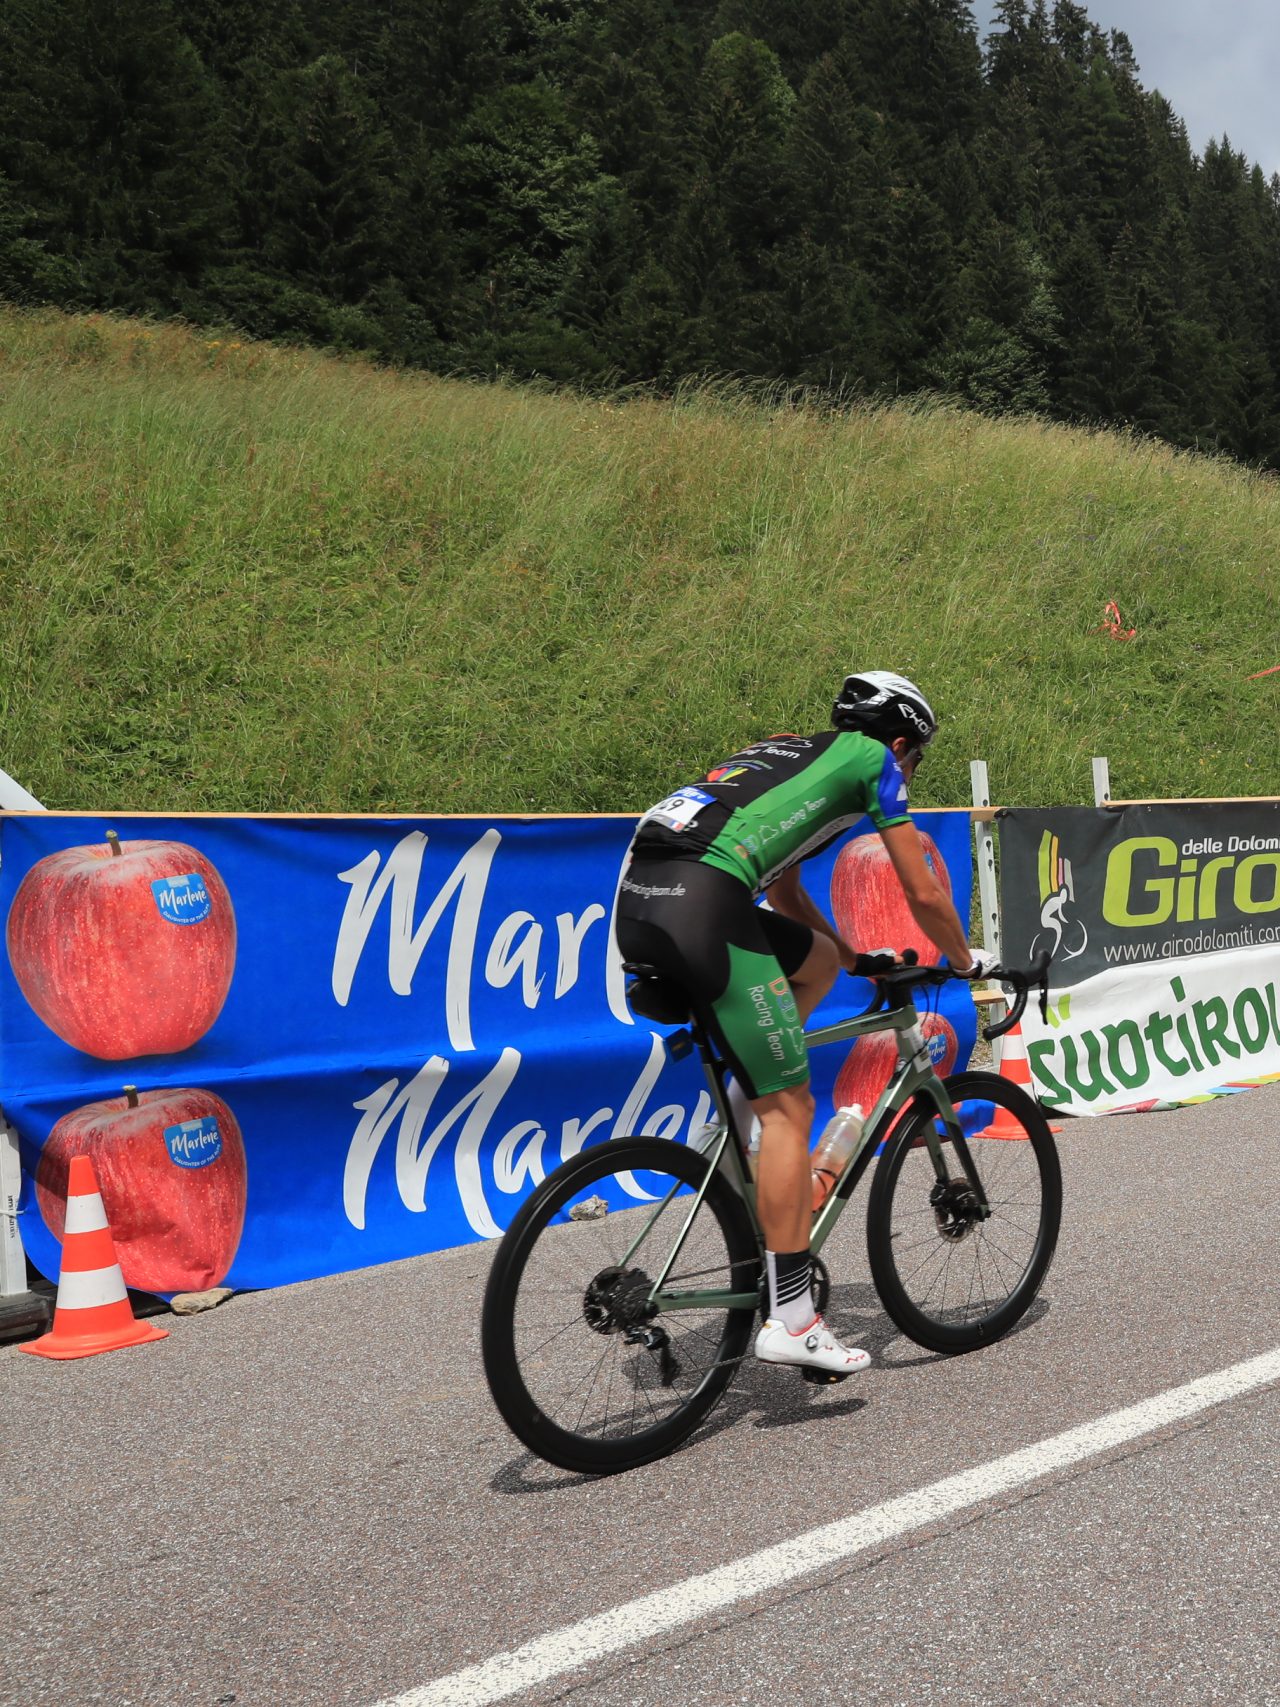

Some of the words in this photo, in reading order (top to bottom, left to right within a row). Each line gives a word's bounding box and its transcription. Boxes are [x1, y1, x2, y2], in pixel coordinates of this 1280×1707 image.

[762, 746, 800, 759] Team
[1181, 837, 1223, 856] delle
[159, 886, 207, 915] Marlene
[747, 984, 775, 1027] Racing
[766, 1027, 786, 1061] Team
[171, 1129, 219, 1159] Marlene
